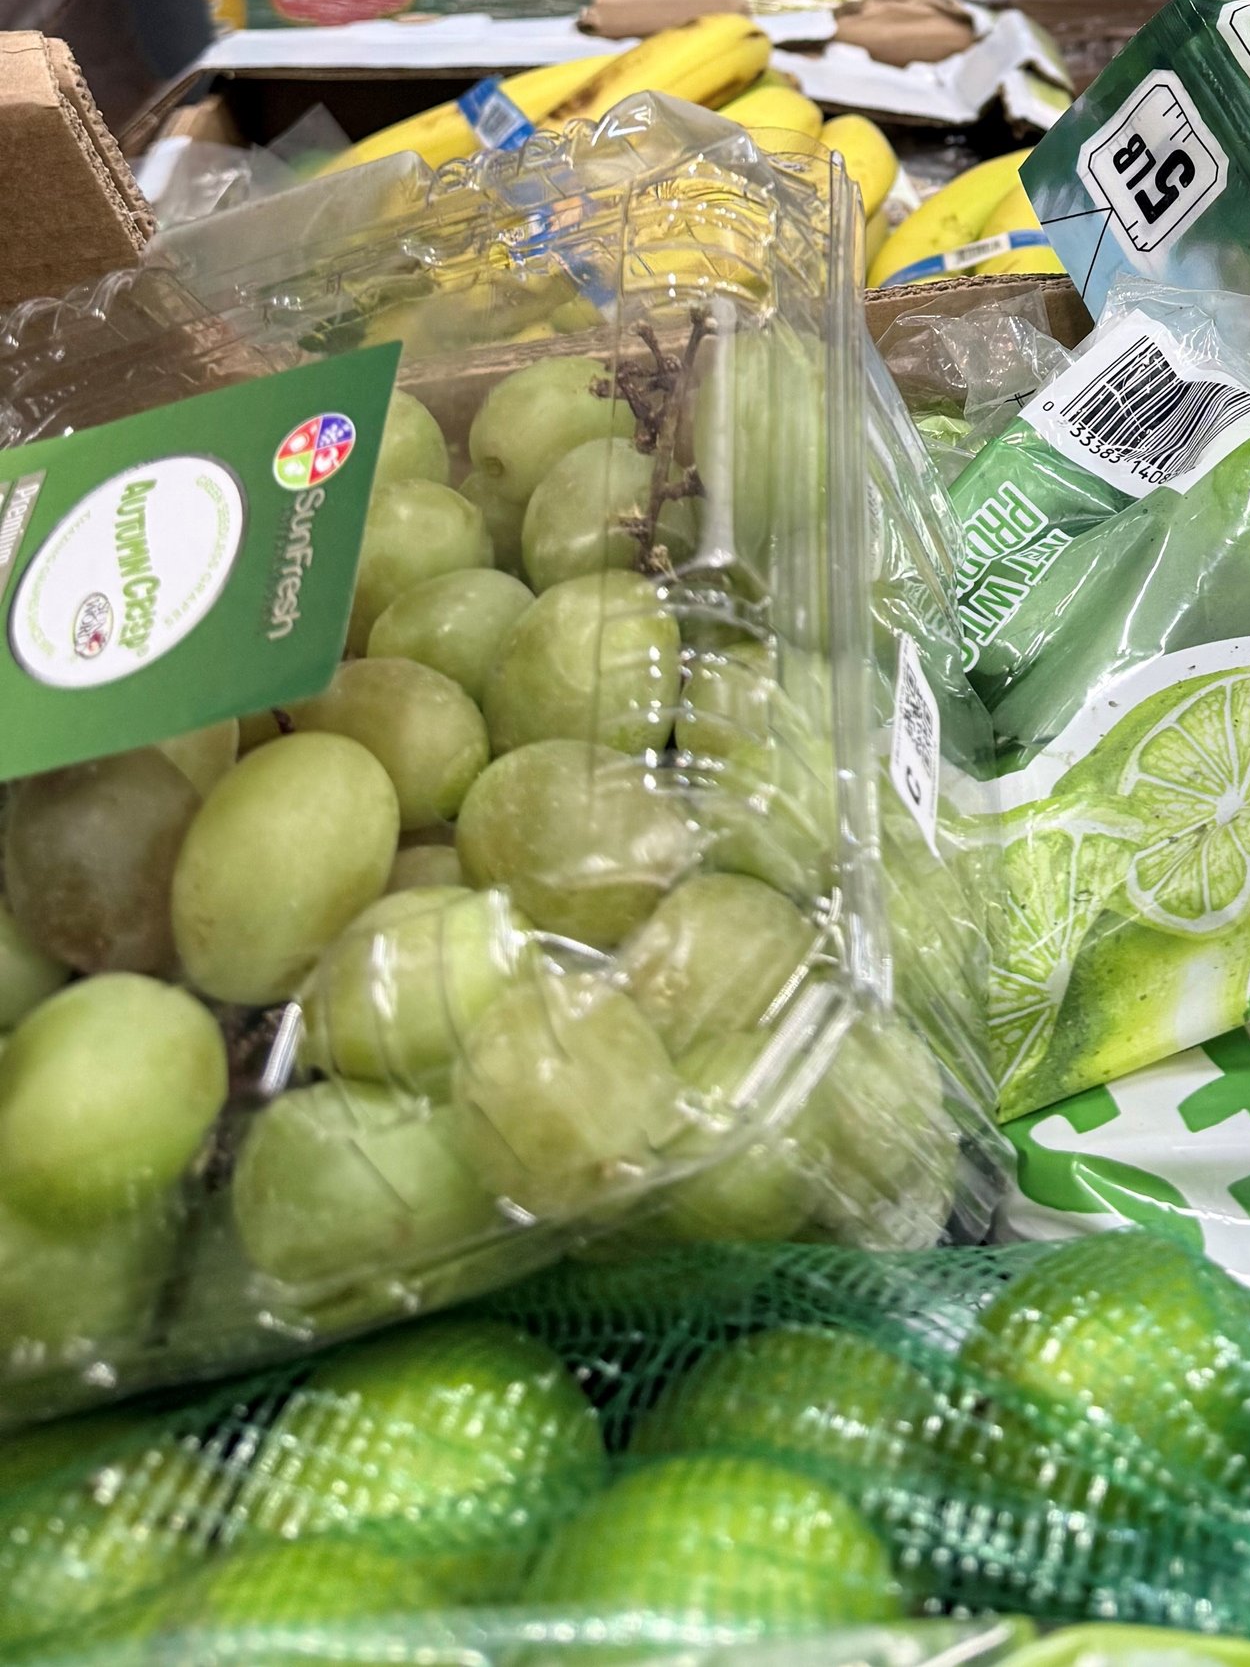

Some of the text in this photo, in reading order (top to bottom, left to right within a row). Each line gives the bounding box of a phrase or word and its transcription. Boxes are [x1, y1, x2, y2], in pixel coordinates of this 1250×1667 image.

[1112, 133, 1196, 225] 5 LB
[1069, 422, 1122, 464] 33383
[0, 483, 40, 566] Premium
[265, 488, 326, 642] SunFresh
